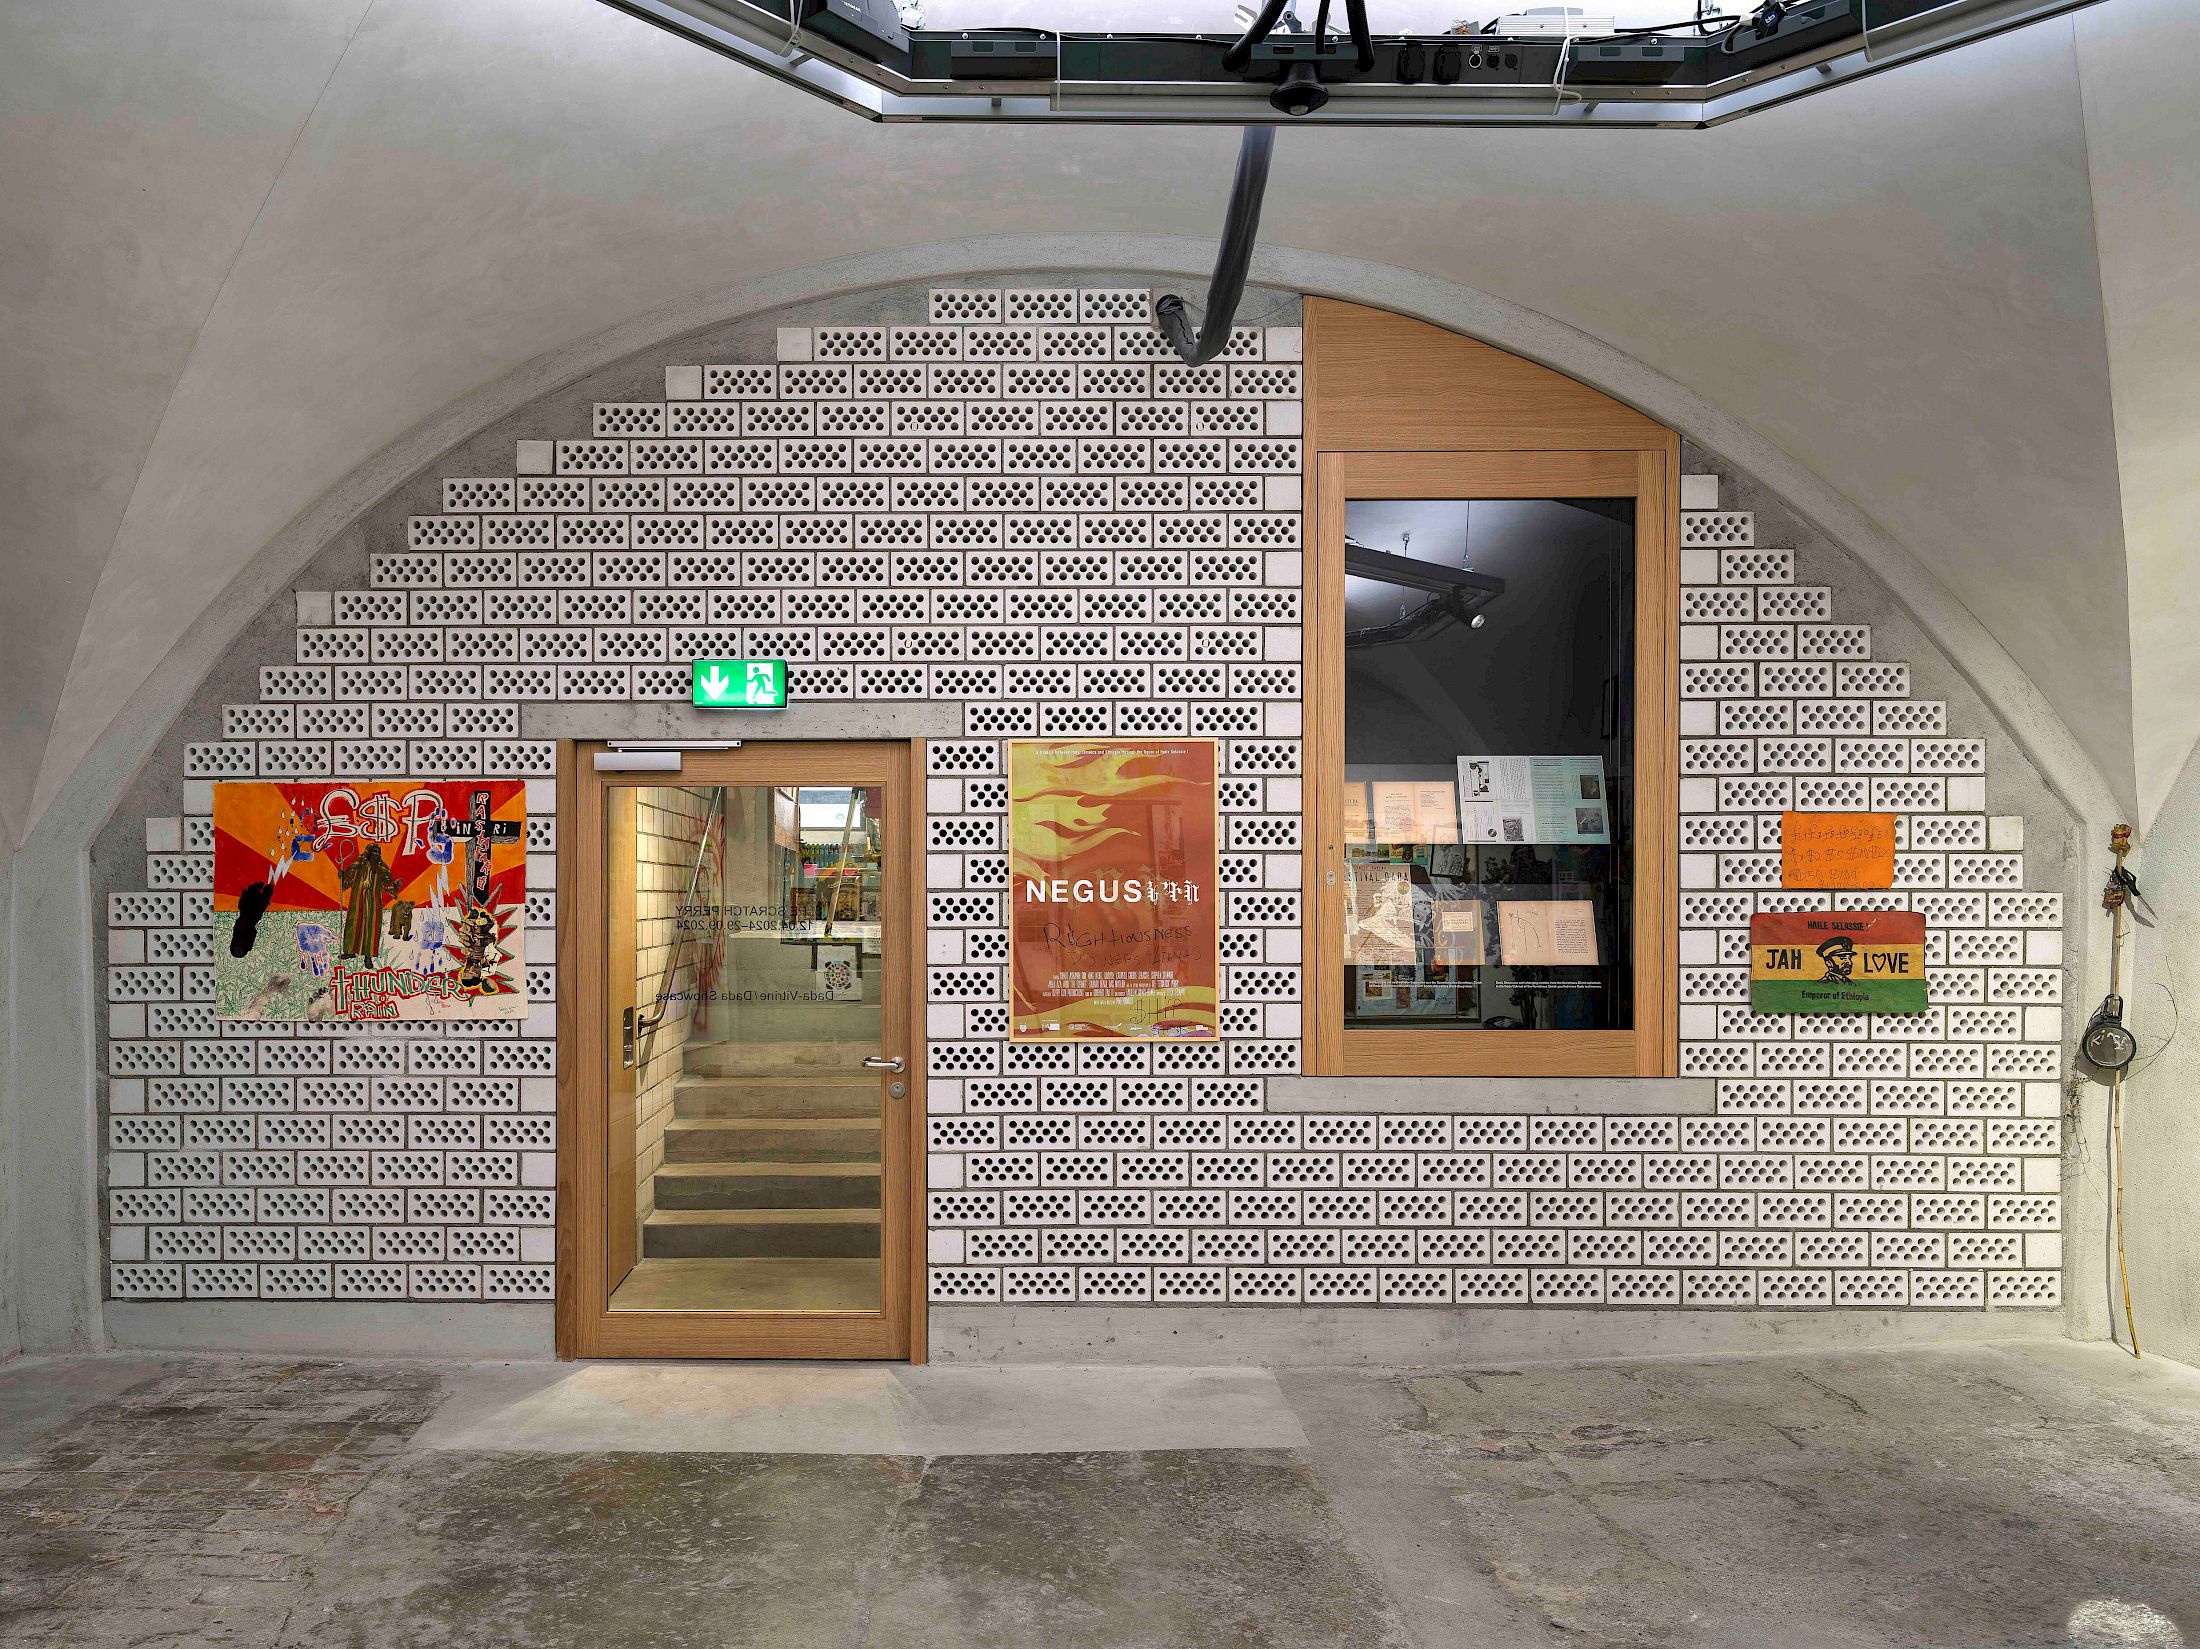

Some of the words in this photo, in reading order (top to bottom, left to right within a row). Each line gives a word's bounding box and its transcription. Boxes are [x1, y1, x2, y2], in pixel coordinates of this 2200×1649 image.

[1026, 879, 1143, 904] NEGUS
[1807, 921, 1828, 930] HAILE
[1765, 949, 1802, 969] JAH
[1801, 990, 1831, 1000] Emperor
[1832, 991, 1840, 1000] of
[1841, 991, 1869, 1001] Ethiopia
[350, 1000, 400, 1020] RAIN
